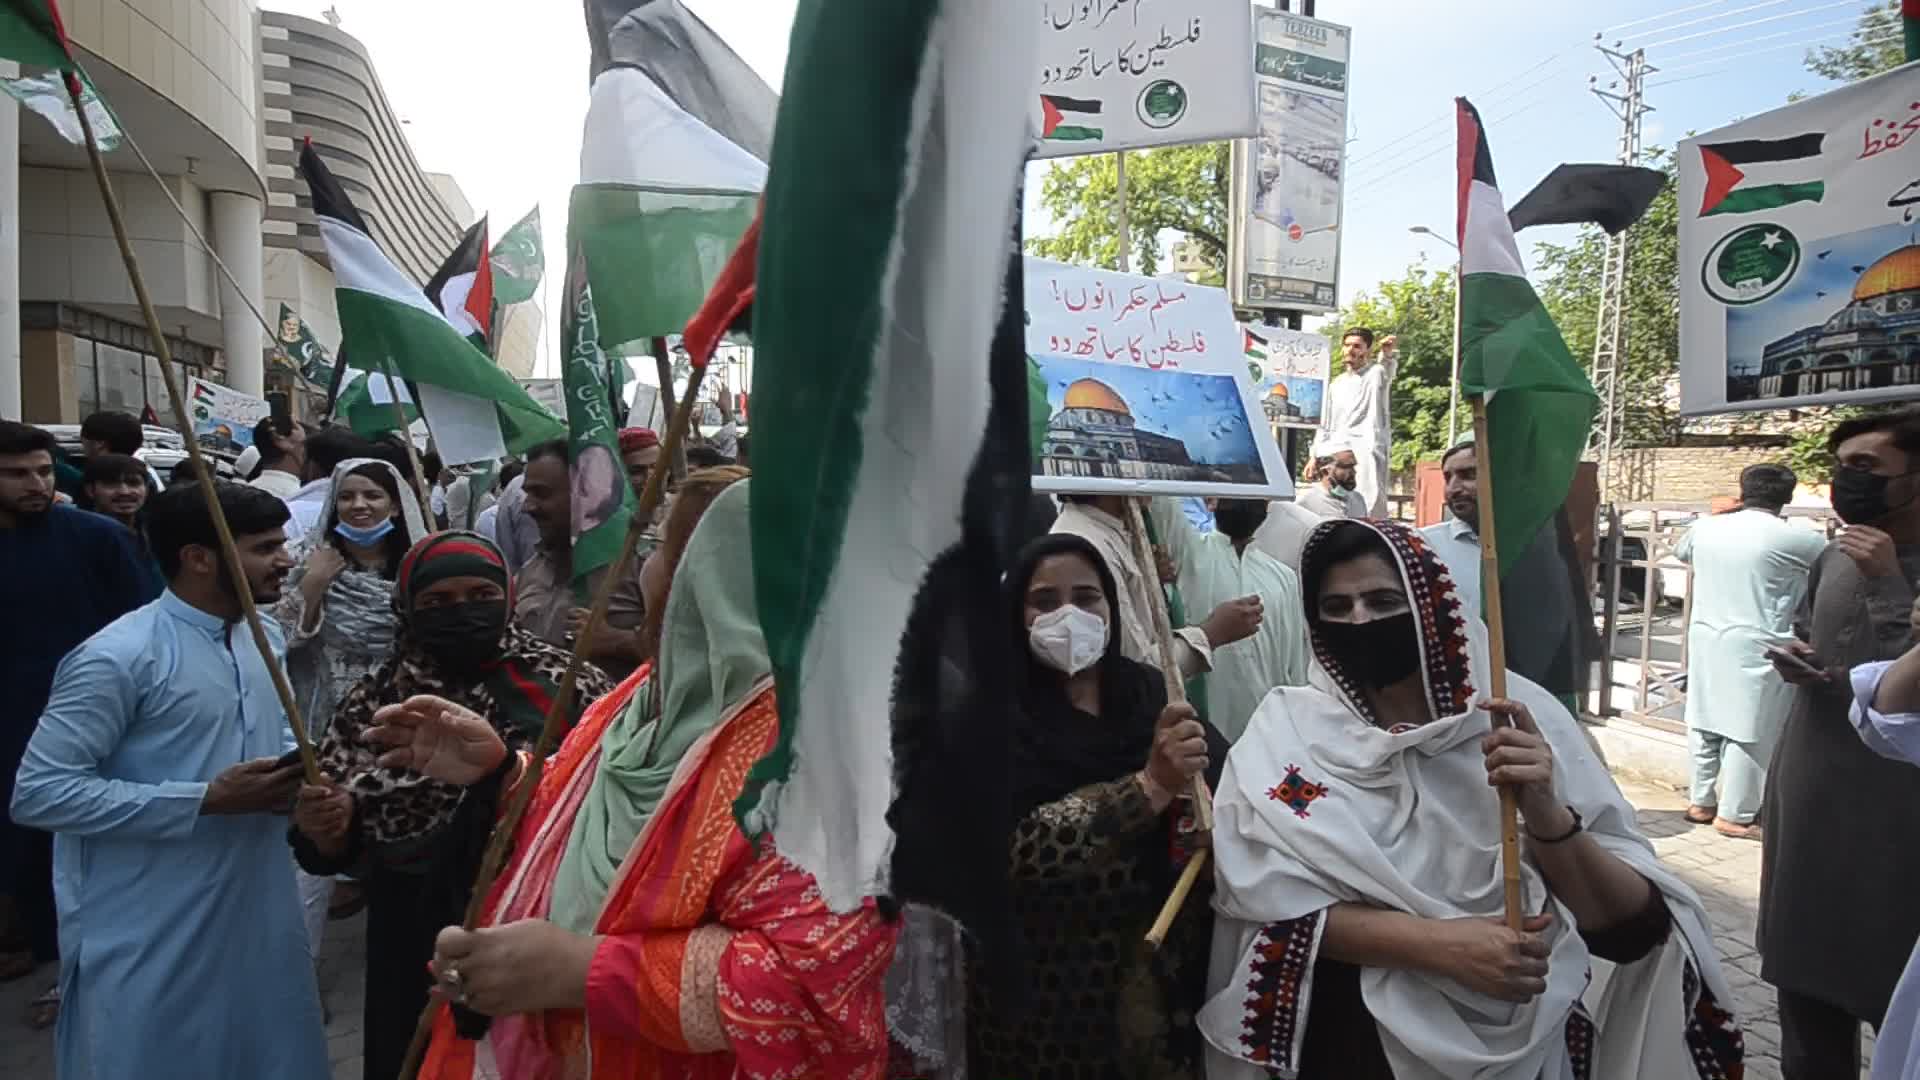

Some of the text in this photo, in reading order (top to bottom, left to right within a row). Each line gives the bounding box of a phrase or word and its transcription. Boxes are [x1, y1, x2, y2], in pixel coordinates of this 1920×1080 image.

[1063, 47, 1113, 82] ساتھ
[1117, 39, 1138, 74] کا
[1130, 18, 1200, 76] فلسطین
[1149, 283, 1186, 334] مسلم
[1050, 327, 1206, 369] فلسطین کا ساتھ دو
